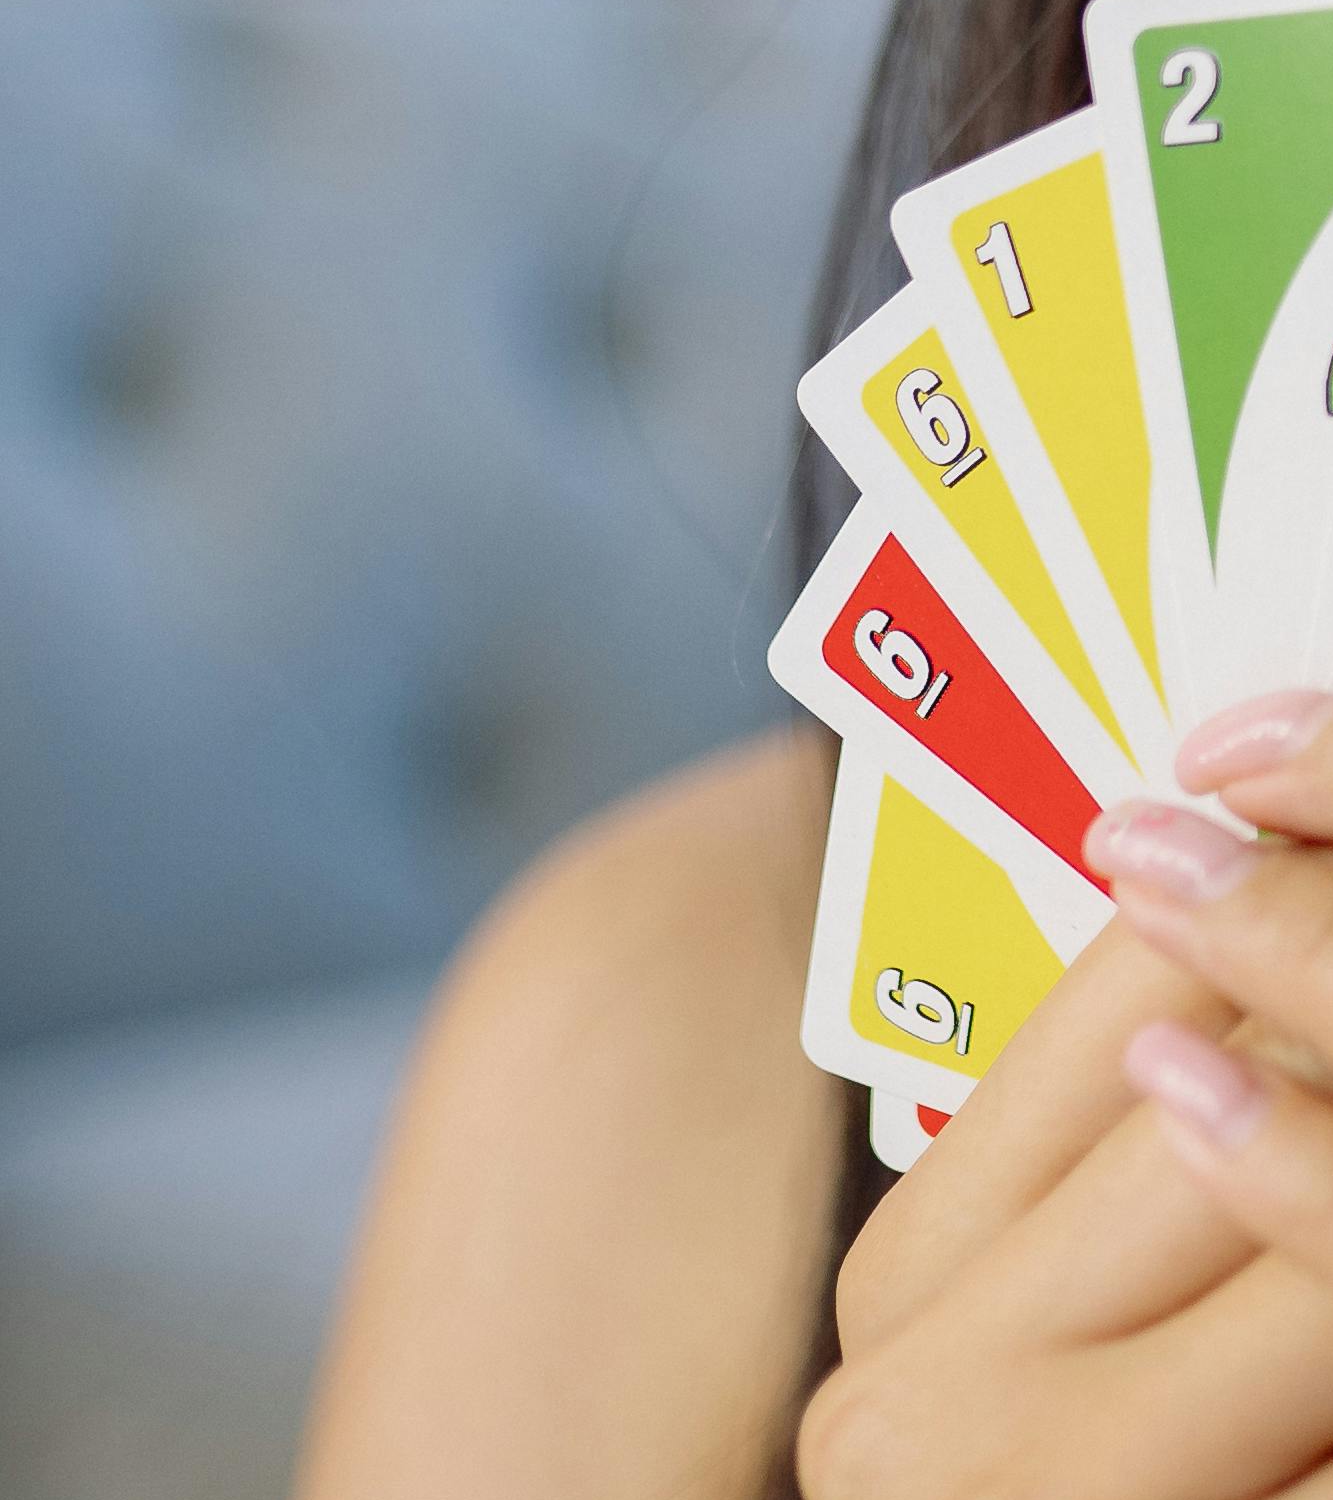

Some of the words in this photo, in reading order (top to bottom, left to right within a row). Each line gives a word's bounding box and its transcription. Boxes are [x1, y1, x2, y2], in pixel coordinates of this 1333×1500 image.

[1159, 48, 1222, 147] 2
[974, 221, 1034, 319] 1
[895, 367, 987, 488] 6
[852, 607, 954, 721] 6
[874, 967, 975, 1056] 6
